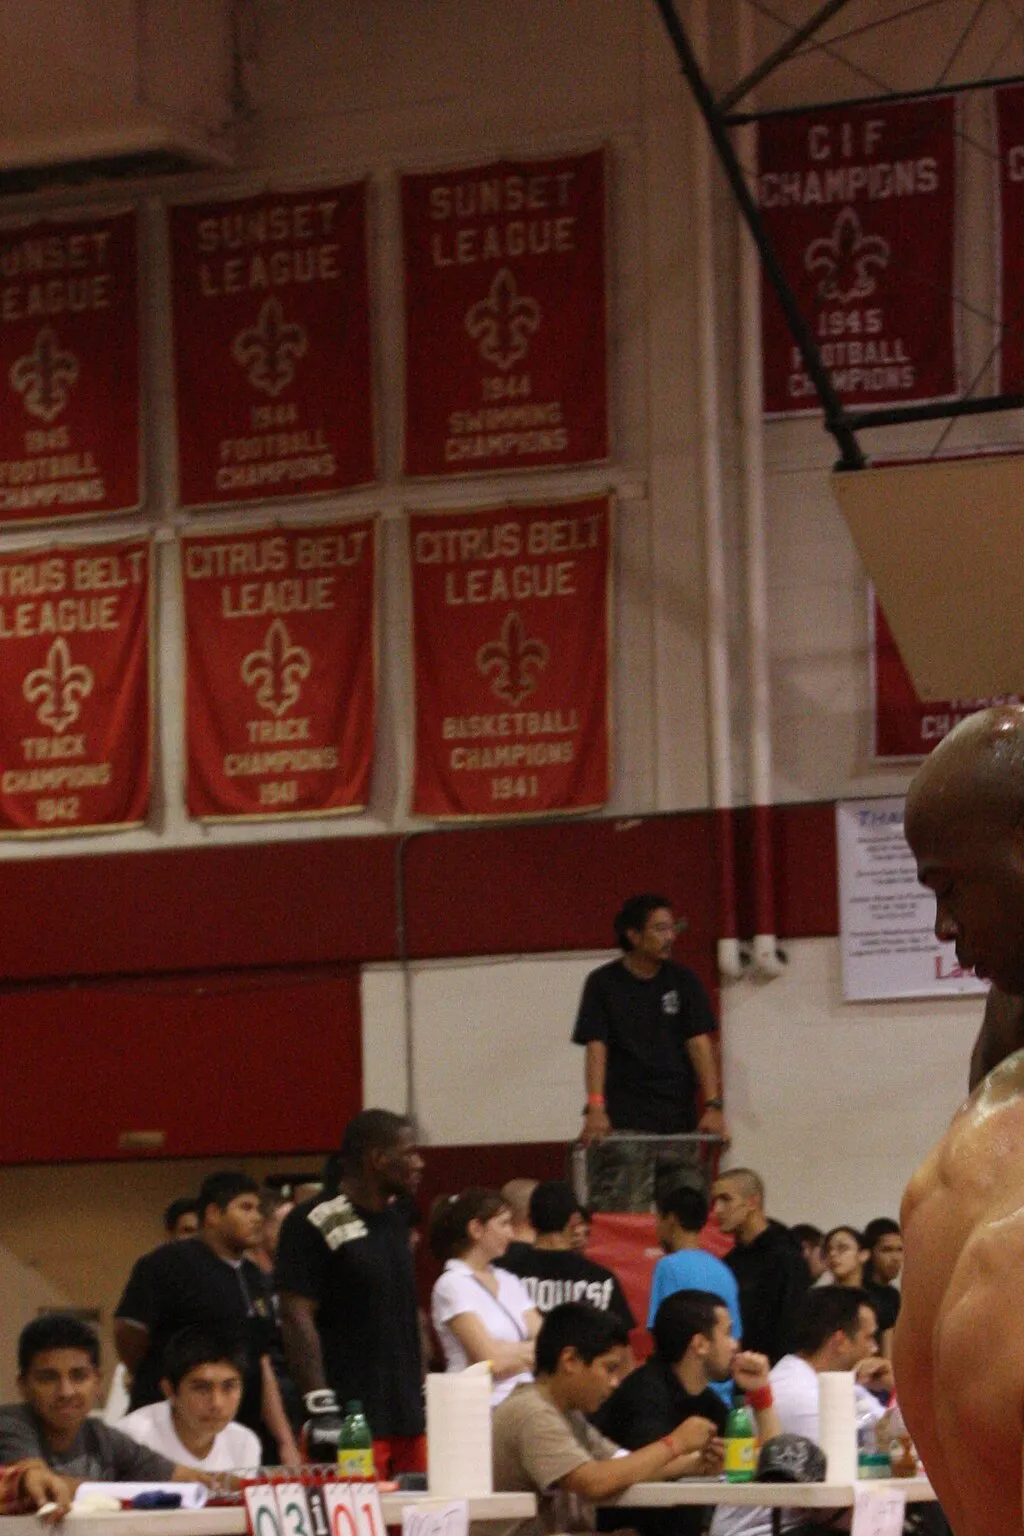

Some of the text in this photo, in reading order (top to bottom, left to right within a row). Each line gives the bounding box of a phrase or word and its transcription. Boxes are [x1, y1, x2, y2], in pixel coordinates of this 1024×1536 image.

[807, 119, 885, 161] CIF
[428, 171, 576, 221] SUNSET
[758, 156, 939, 208] CHAMPIONS
[198, 201, 339, 253] SUNSET
[430, 215, 580, 268] LEAGUE
[201, 244, 341, 297] LEAGUE
[817, 308, 883, 336] 1945
[219, 427, 331, 464] FOOTBALL
[444, 427, 569, 462] CHAMPIONS
[215, 453, 339, 491] CHAMPIONS
[186, 532, 368, 580] CITRUS BELT
[415, 512, 604, 565] CITRUS BELT
[73, 550, 147, 590] BELT
[444, 561, 577, 606] LEAGUE
[222, 576, 338, 619] LEAGUE
[246, 717, 312, 743] TRACK
[442, 709, 579, 740] BASKETBALL
[20, 734, 88, 761] TRACK
[223, 747, 339, 777] CHAMPIONS
[451, 741, 576, 771] CHAMPIONS
[2, 762, 112, 795] CHAMPIONS
[490, 775, 540, 800] 1941
